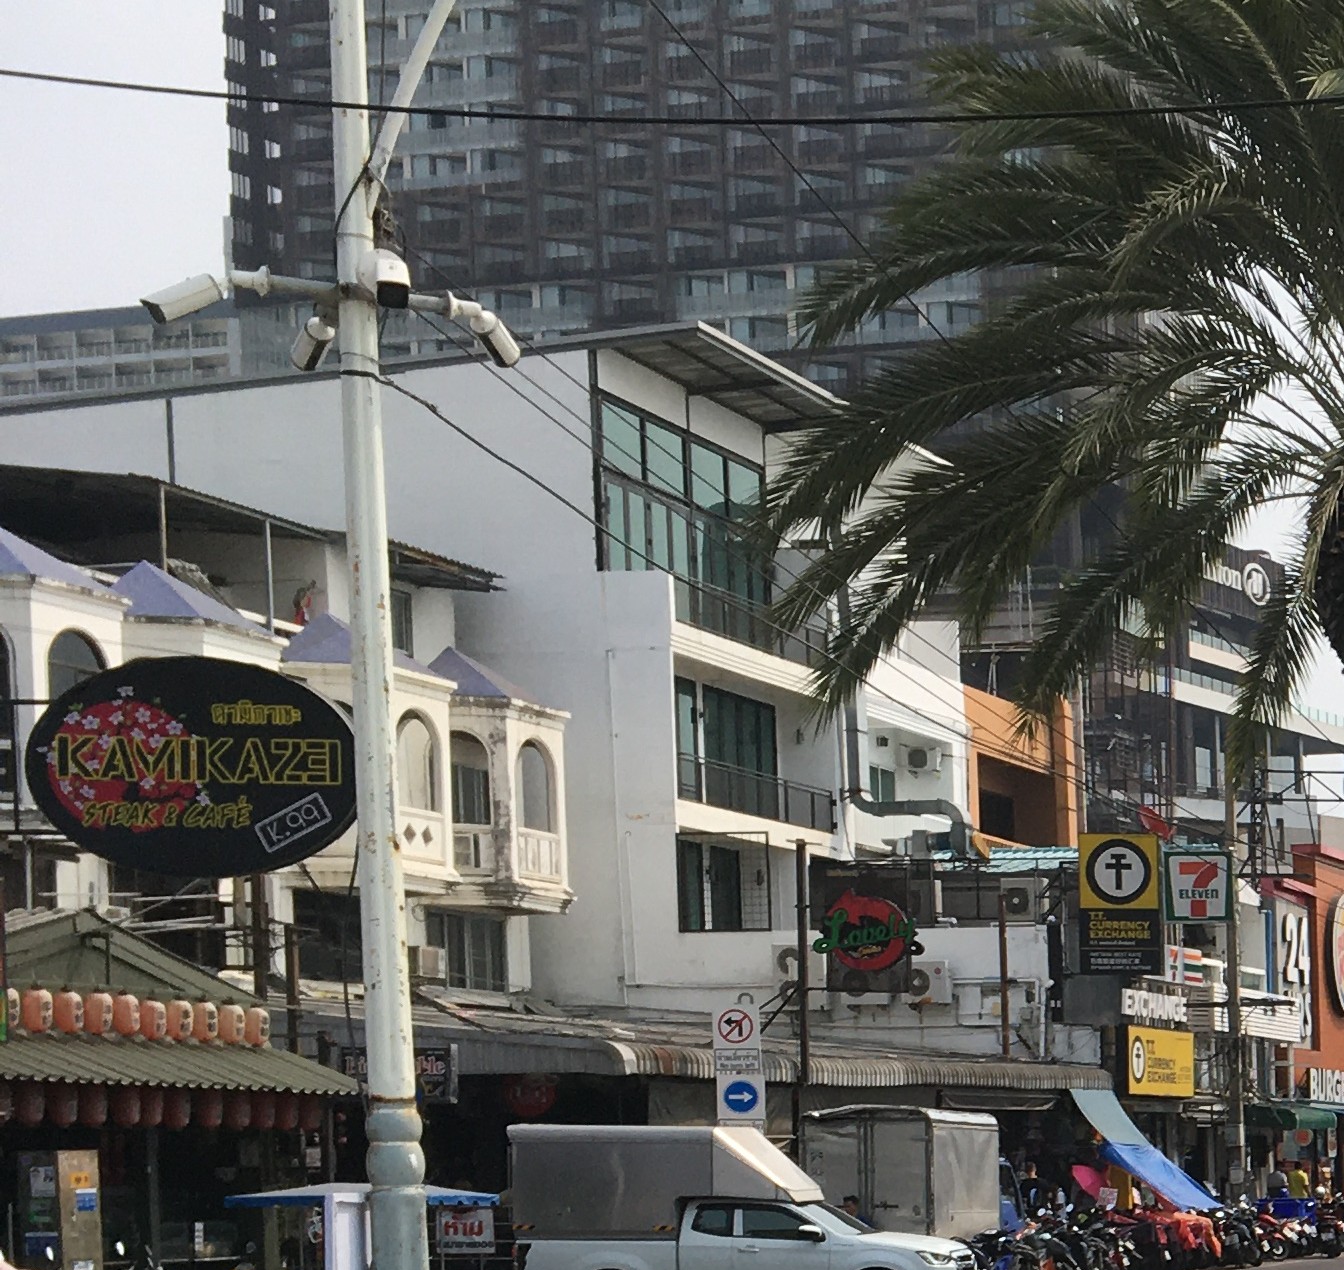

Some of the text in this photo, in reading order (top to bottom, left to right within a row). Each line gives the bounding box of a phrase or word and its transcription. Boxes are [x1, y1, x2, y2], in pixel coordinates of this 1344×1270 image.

[82, 795, 253, 828] STEAK & CAFÉ
[268, 802, 321, 843] K.99
[1179, 861, 1219, 917] 7
[812, 908, 915, 954] Lovely
[1089, 921, 1150, 930] CURRENCY
[1089, 930, 1152, 939] EXCHANGE
[1282, 913, 1310, 986] 24
[1122, 988, 1187, 1023] EXCHANGE
